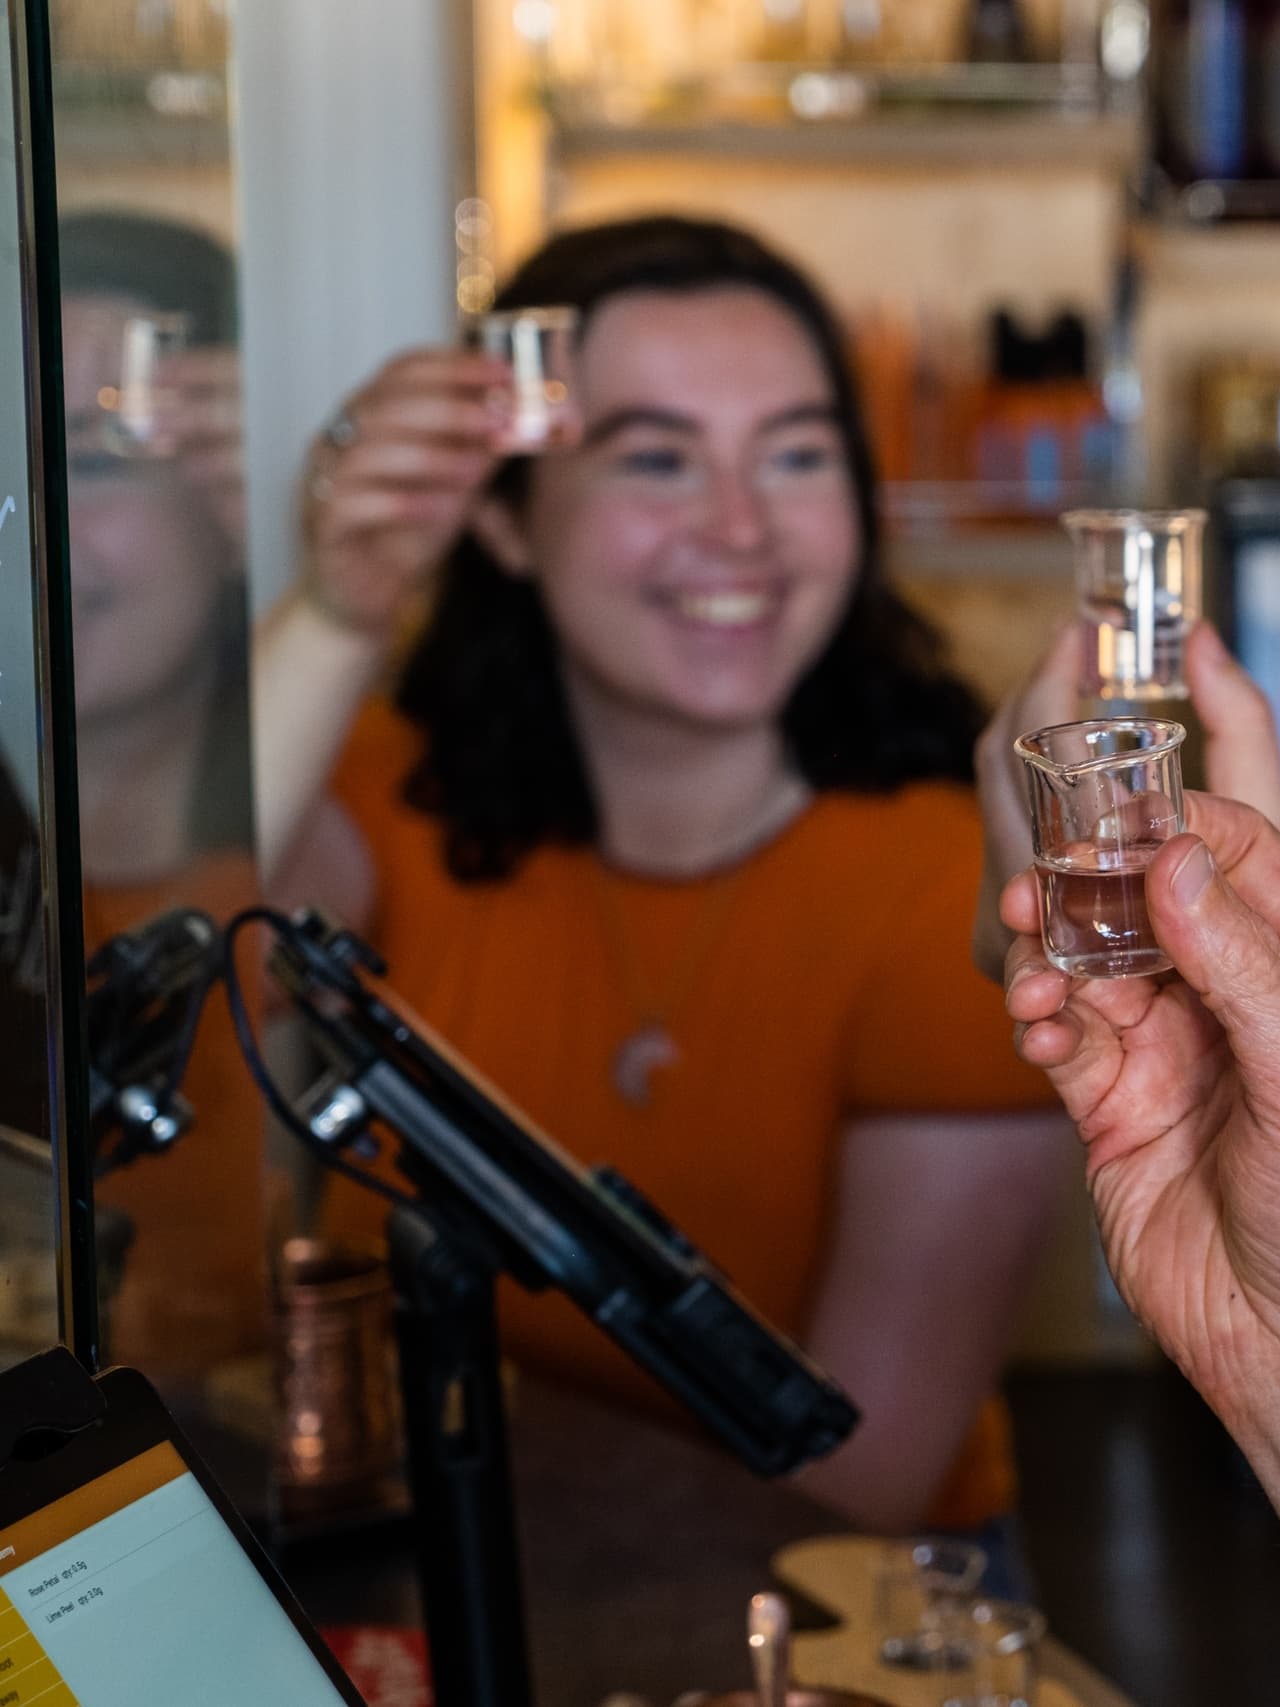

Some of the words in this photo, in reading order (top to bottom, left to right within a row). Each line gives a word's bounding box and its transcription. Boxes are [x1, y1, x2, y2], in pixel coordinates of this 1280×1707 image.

[1149, 817, 1161, 829] 25
[28, 1585, 45, 1597] Rose
[43, 1574, 60, 1589] Petal
[45, 1611, 62, 1624] Lime
[60, 1602, 75, 1615] Peel
